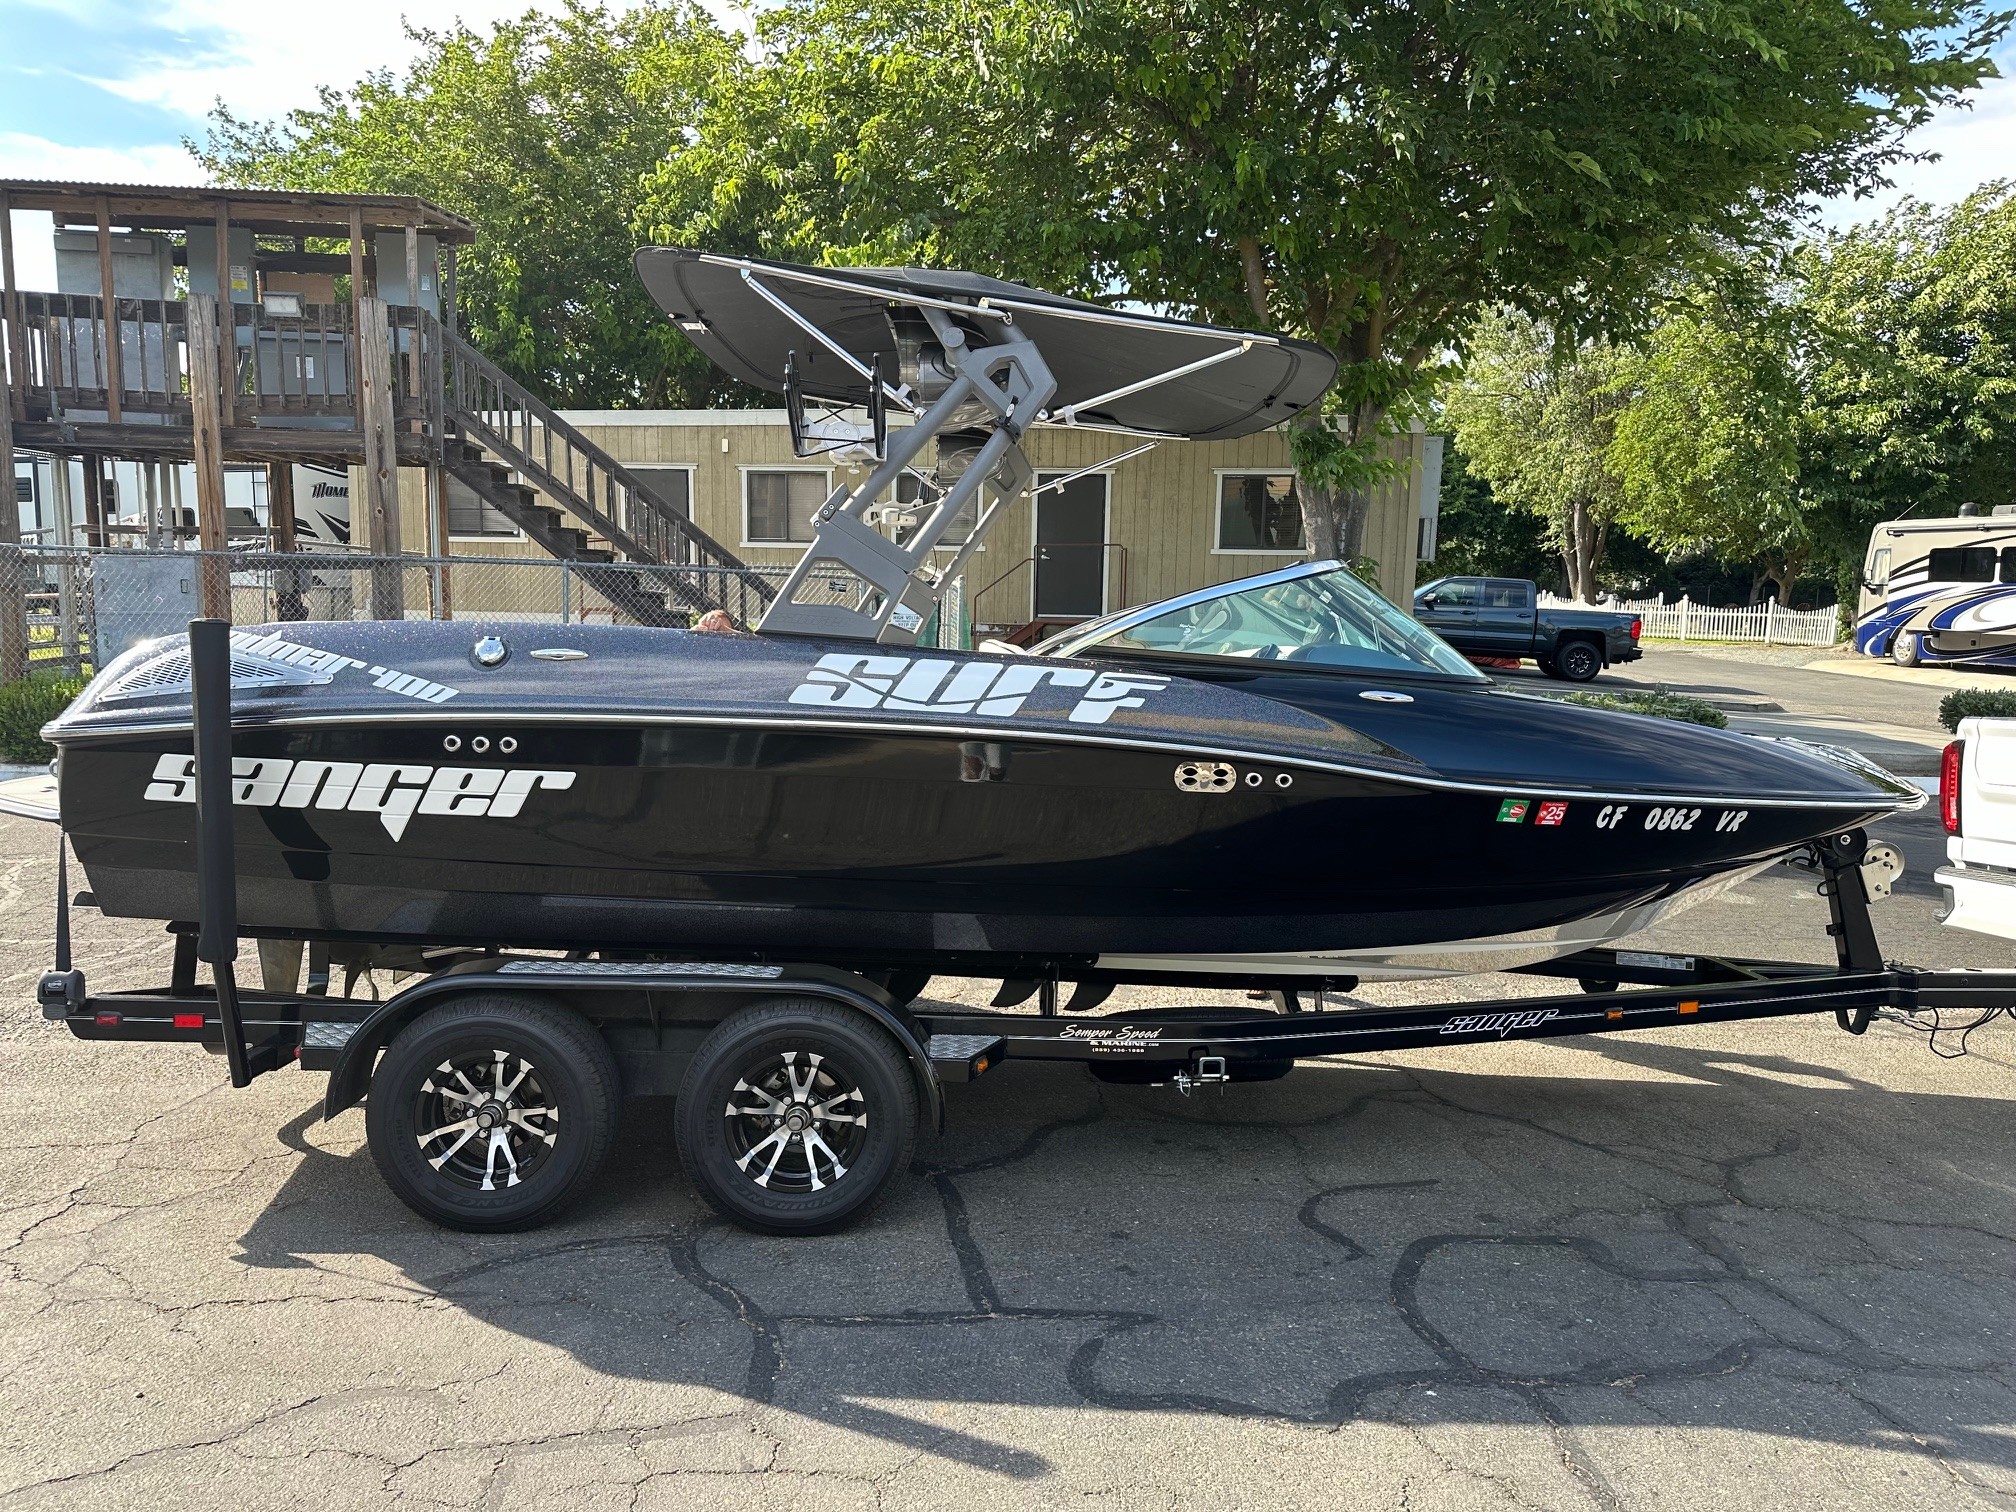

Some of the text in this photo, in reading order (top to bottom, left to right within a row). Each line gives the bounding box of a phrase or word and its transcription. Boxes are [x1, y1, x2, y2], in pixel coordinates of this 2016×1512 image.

[368, 665, 460, 704] 400
[144, 753, 577, 842] sanger
[1545, 806, 1566, 820] 25
[1596, 805, 1748, 832] CF 0862 VR
[1060, 1024, 1162, 1042] Semper Speed
[1440, 1009, 1559, 1038] sanger
[726, 1173, 850, 1212] ENDURANCE
